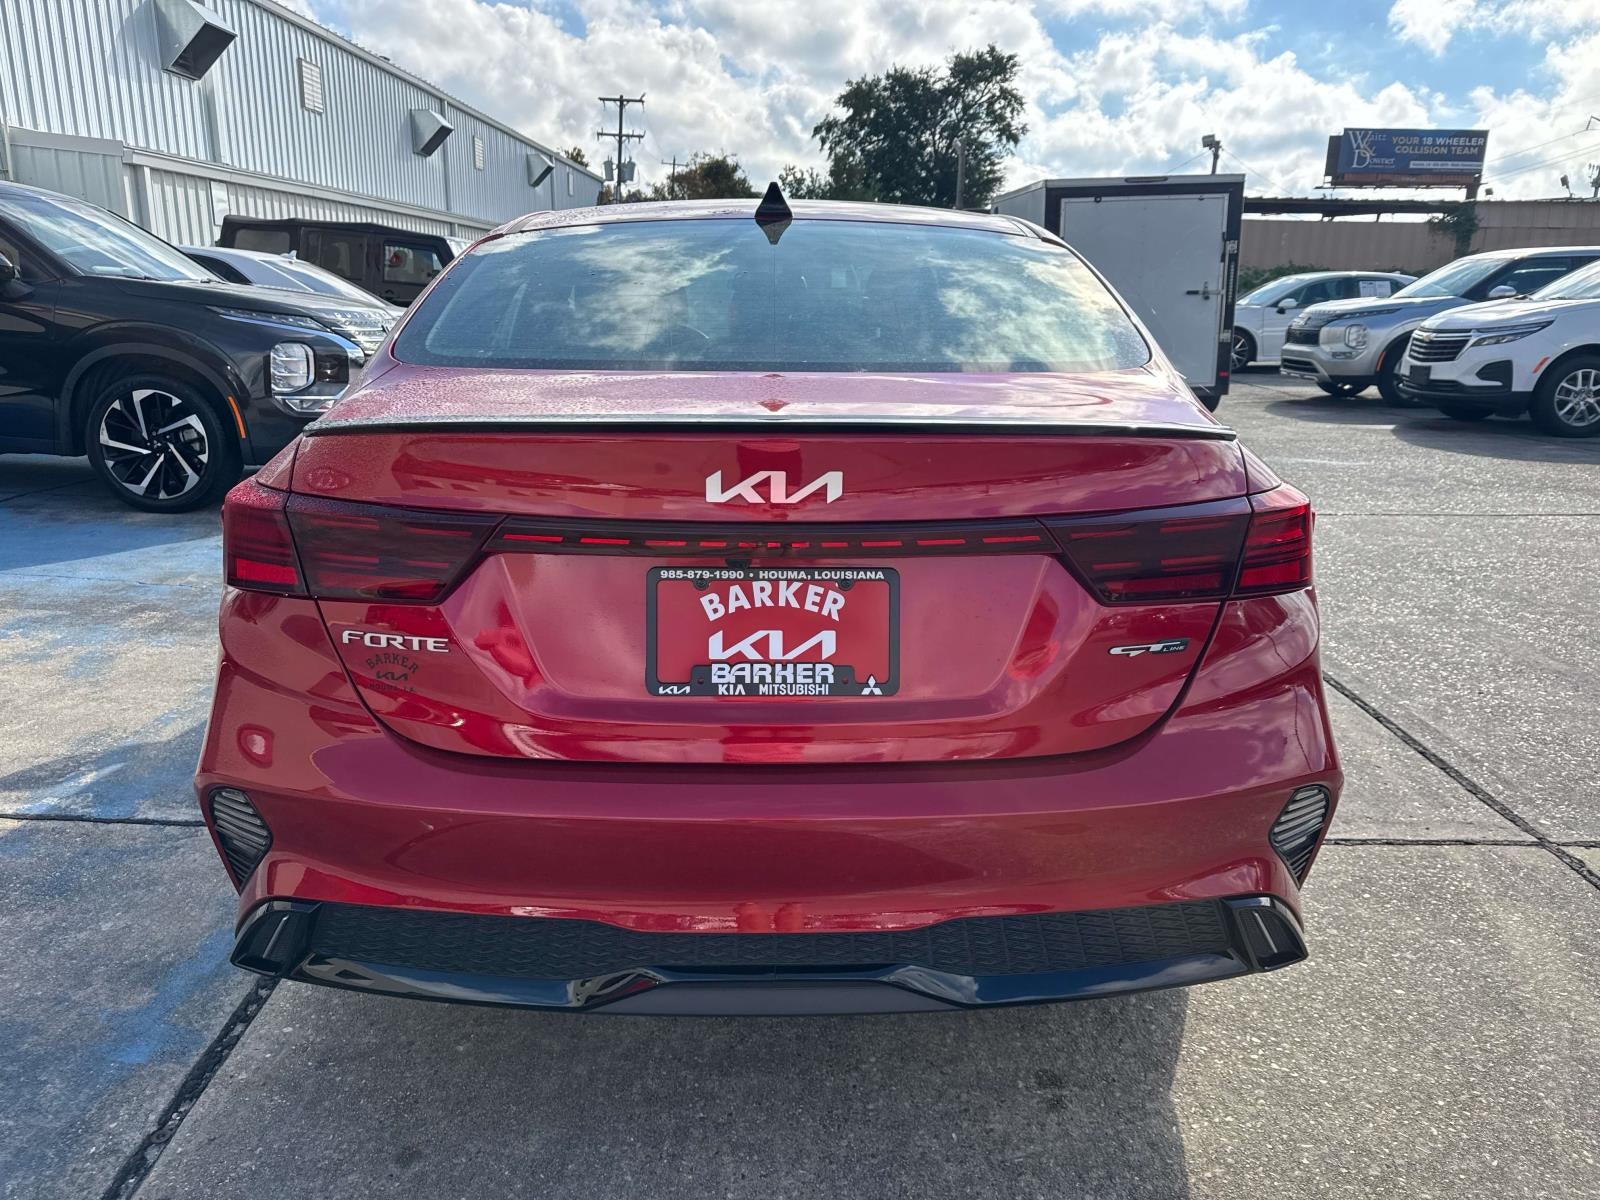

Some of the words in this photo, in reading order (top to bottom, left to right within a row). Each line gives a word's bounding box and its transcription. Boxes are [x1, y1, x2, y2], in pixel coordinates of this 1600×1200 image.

[1392, 136, 1420, 145] YOUR
[1422, 137, 1433, 145] 18
[1436, 137, 1485, 146] WHEELER
[1395, 145, 1448, 154] COLLISION
[1450, 146, 1479, 155] TEAM
[705, 470, 844, 504] KIA
[660, 570, 744, 579] 985-879-1990
[759, 571, 812, 581] HOUMA,
[814, 571, 885, 580] LOUISIANA
[700, 580, 845, 621] BARKER
[342, 630, 449, 652] FORTE
[708, 630, 837, 661] KIA
[658, 685, 691, 695] KIA
[718, 684, 746, 695] KIA
[759, 684, 829, 695] MITSUBISHI
